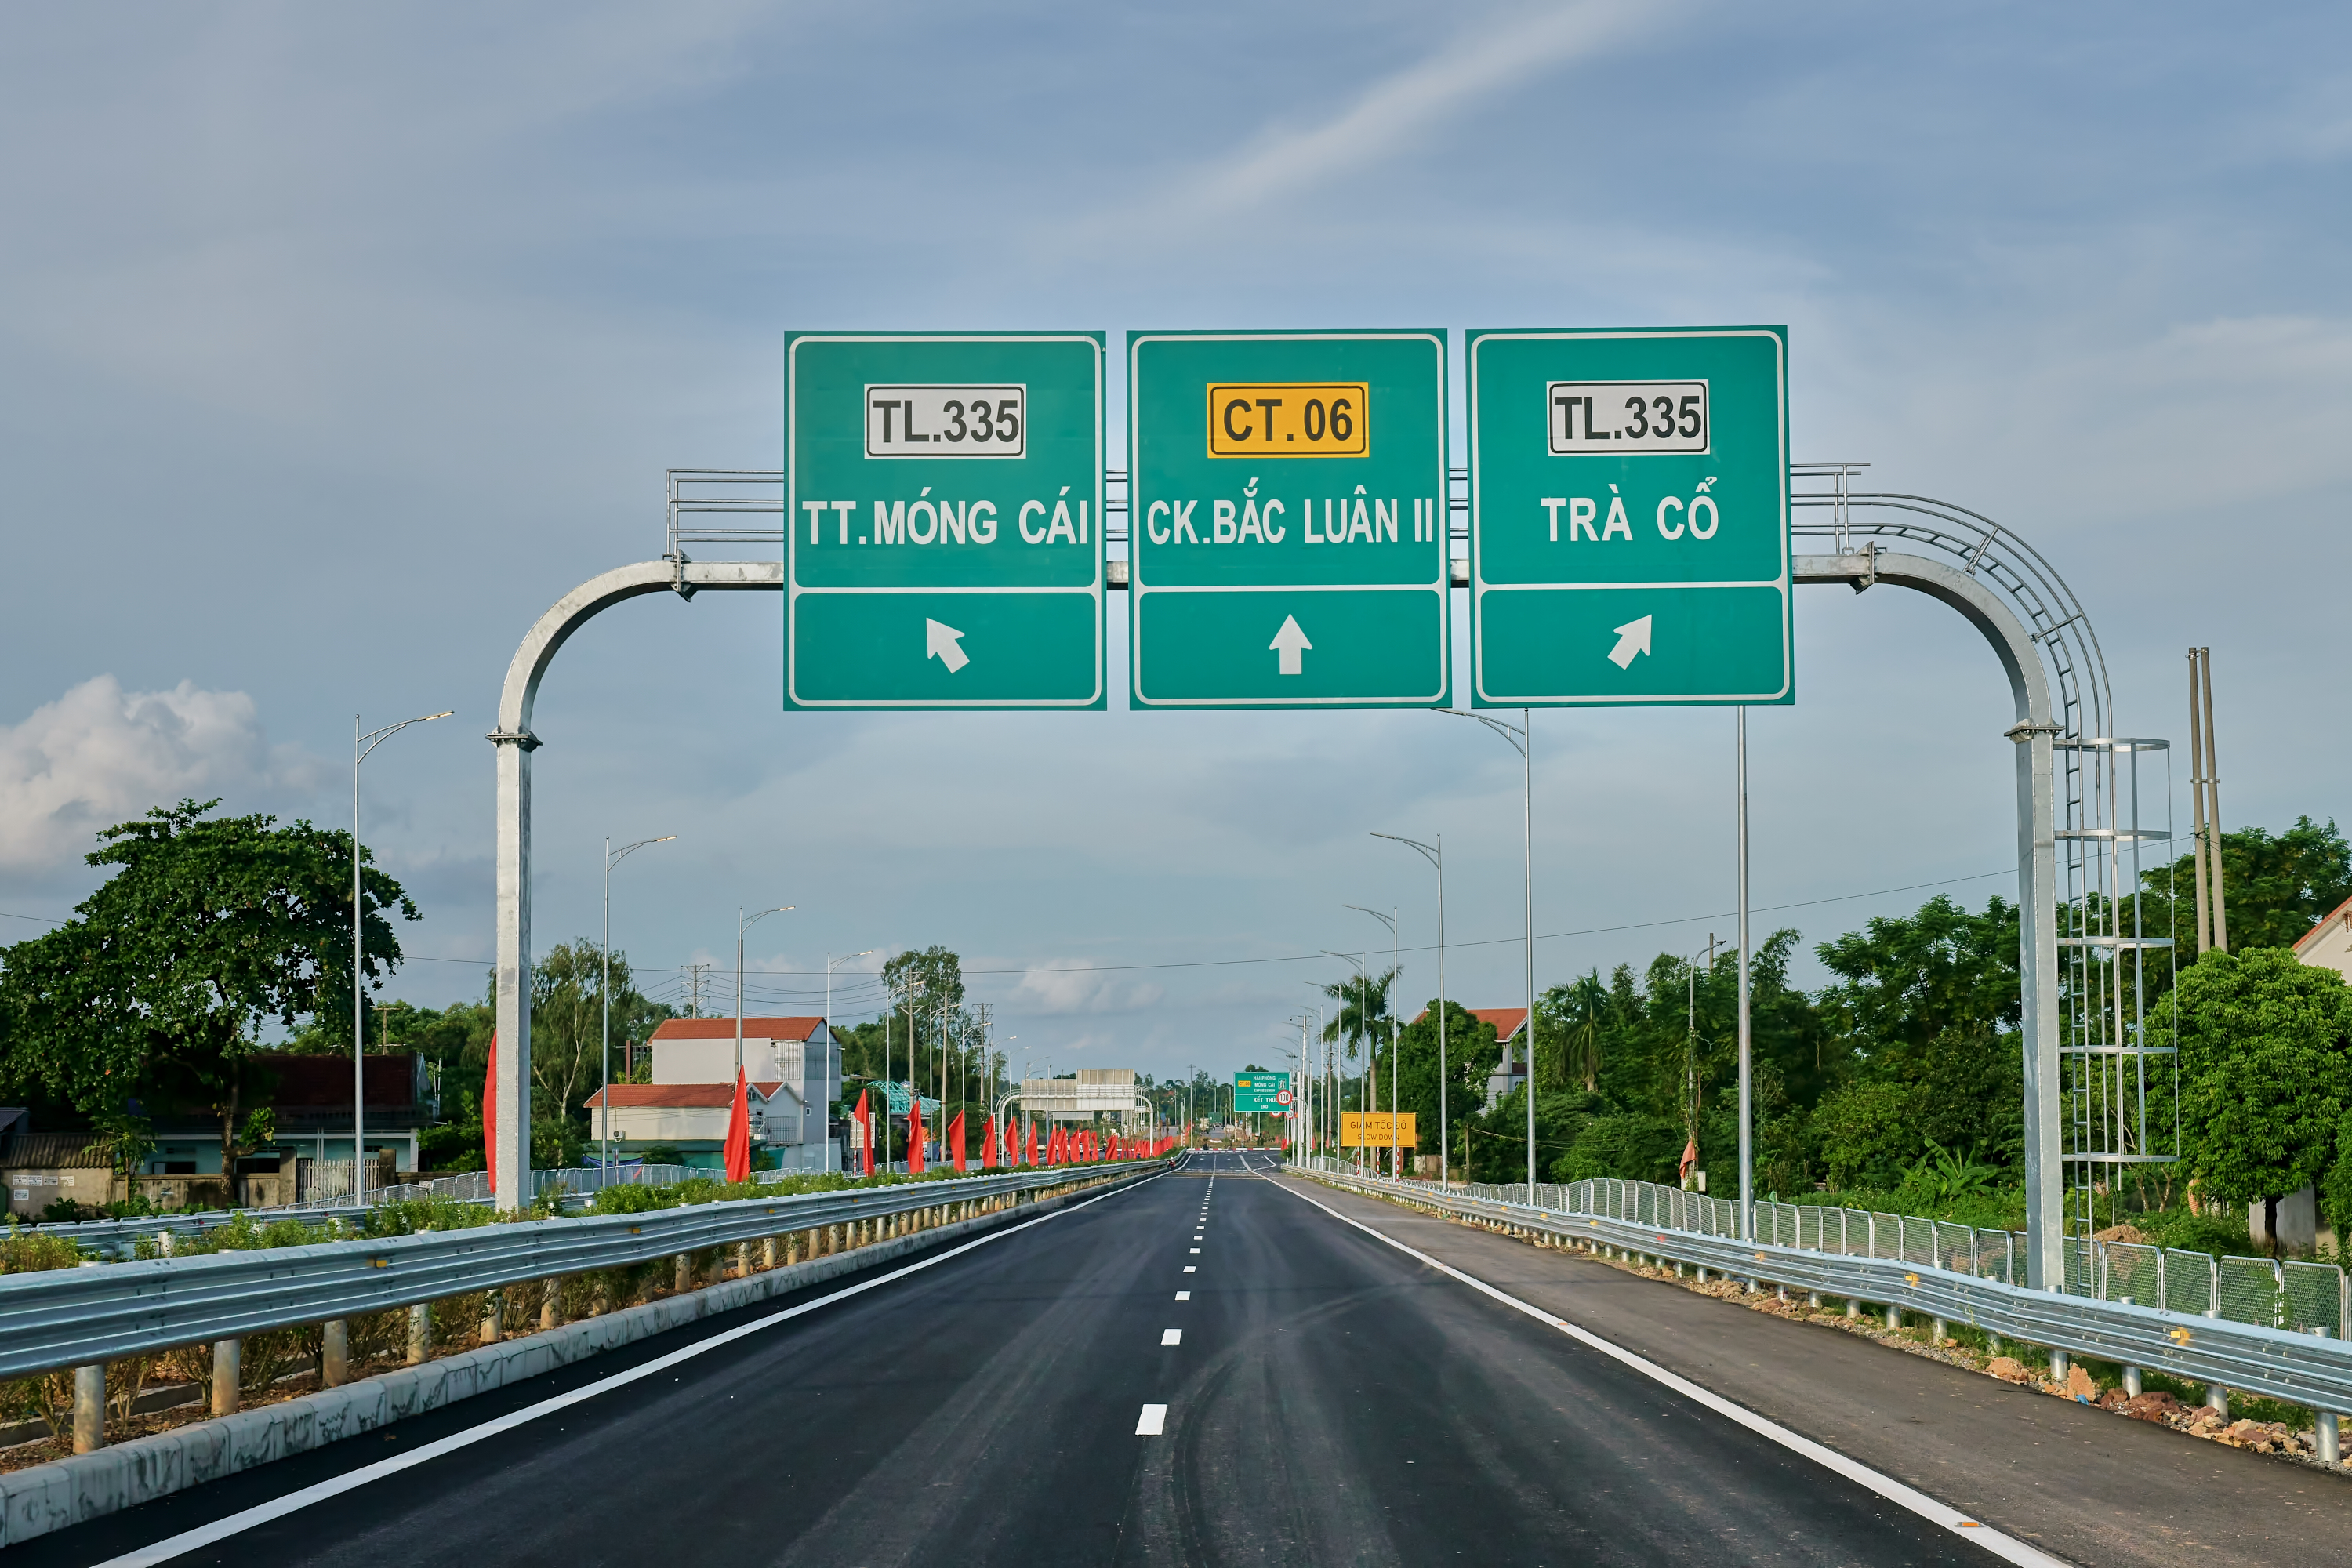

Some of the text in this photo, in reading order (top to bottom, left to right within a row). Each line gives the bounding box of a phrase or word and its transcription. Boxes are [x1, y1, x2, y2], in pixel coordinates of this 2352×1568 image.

[873, 399, 1019, 443] TL.335
[1224, 398, 1353, 441] CT.06
[1554, 395, 1702, 440] TL.335
[802, 485, 1088, 545] TT.MÓNG CÁI
[1147, 477, 1433, 545] CK.BẮC LUÂN II
[1540, 476, 1719, 542] TRÀ CỔ
[1375, 1119, 1392, 1130] TỐC
